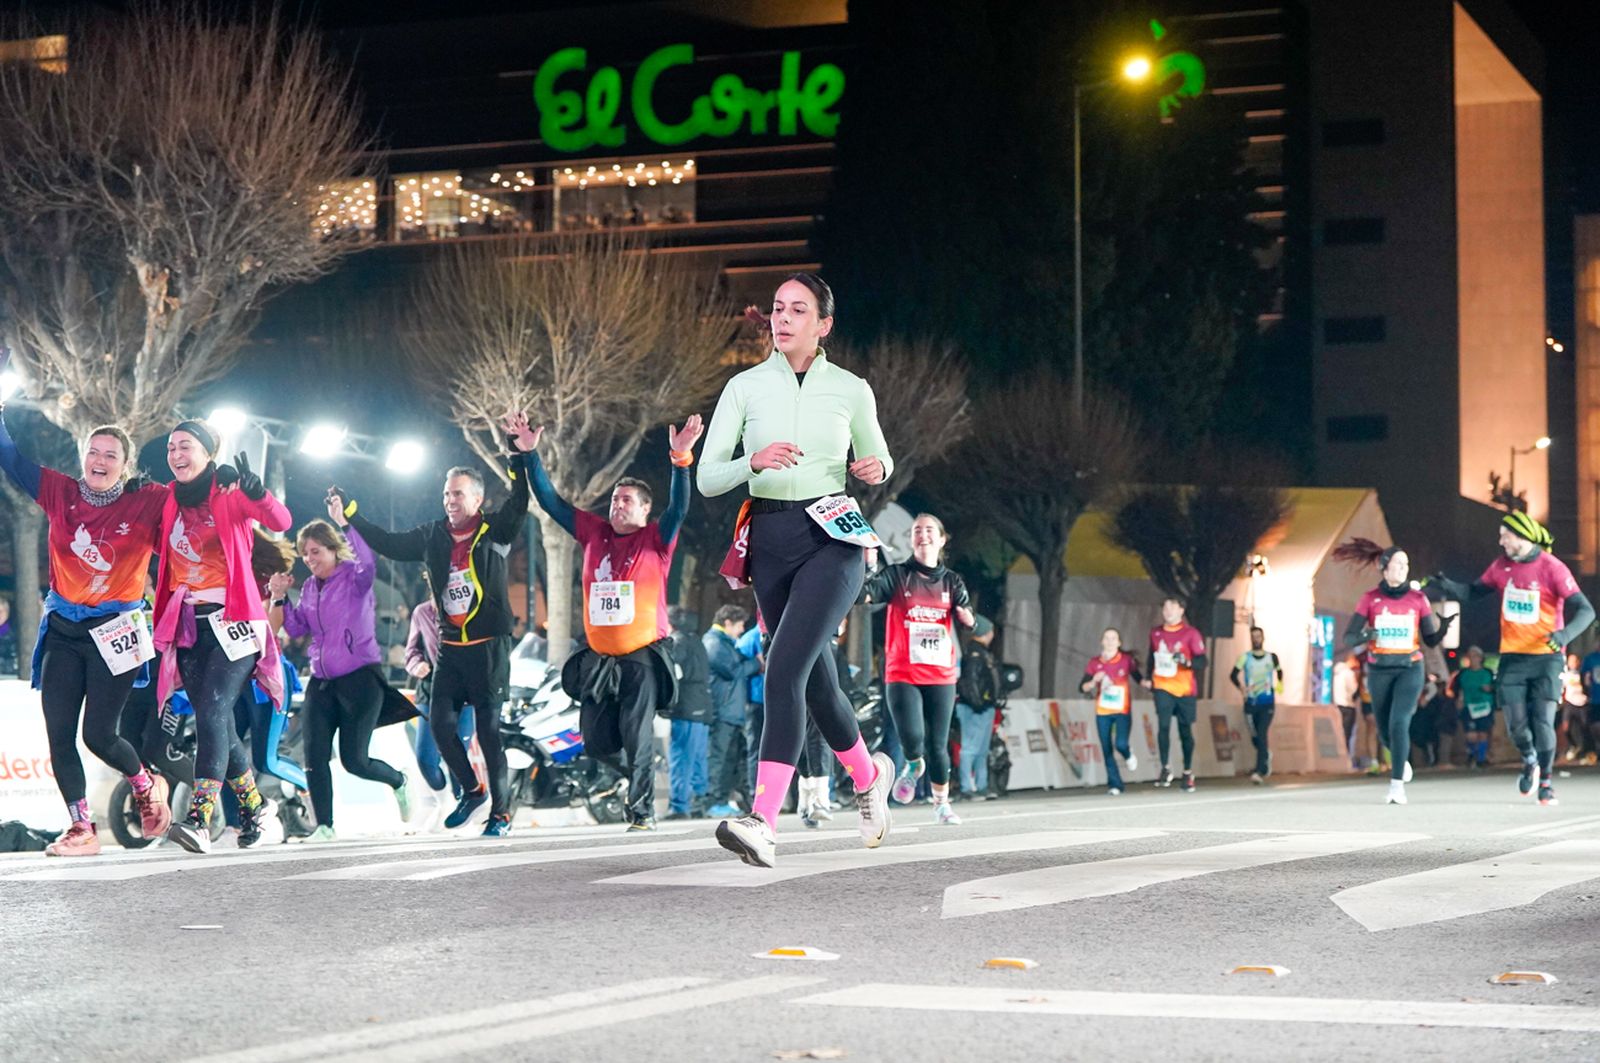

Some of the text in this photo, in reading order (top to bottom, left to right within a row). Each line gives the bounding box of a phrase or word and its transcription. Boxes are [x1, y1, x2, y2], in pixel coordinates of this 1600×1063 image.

[533, 43, 846, 151] El Corte
[176, 540, 189, 554] 43
[82, 548, 98, 563] 43
[449, 585, 471, 601] 659
[600, 597, 621, 610] 784
